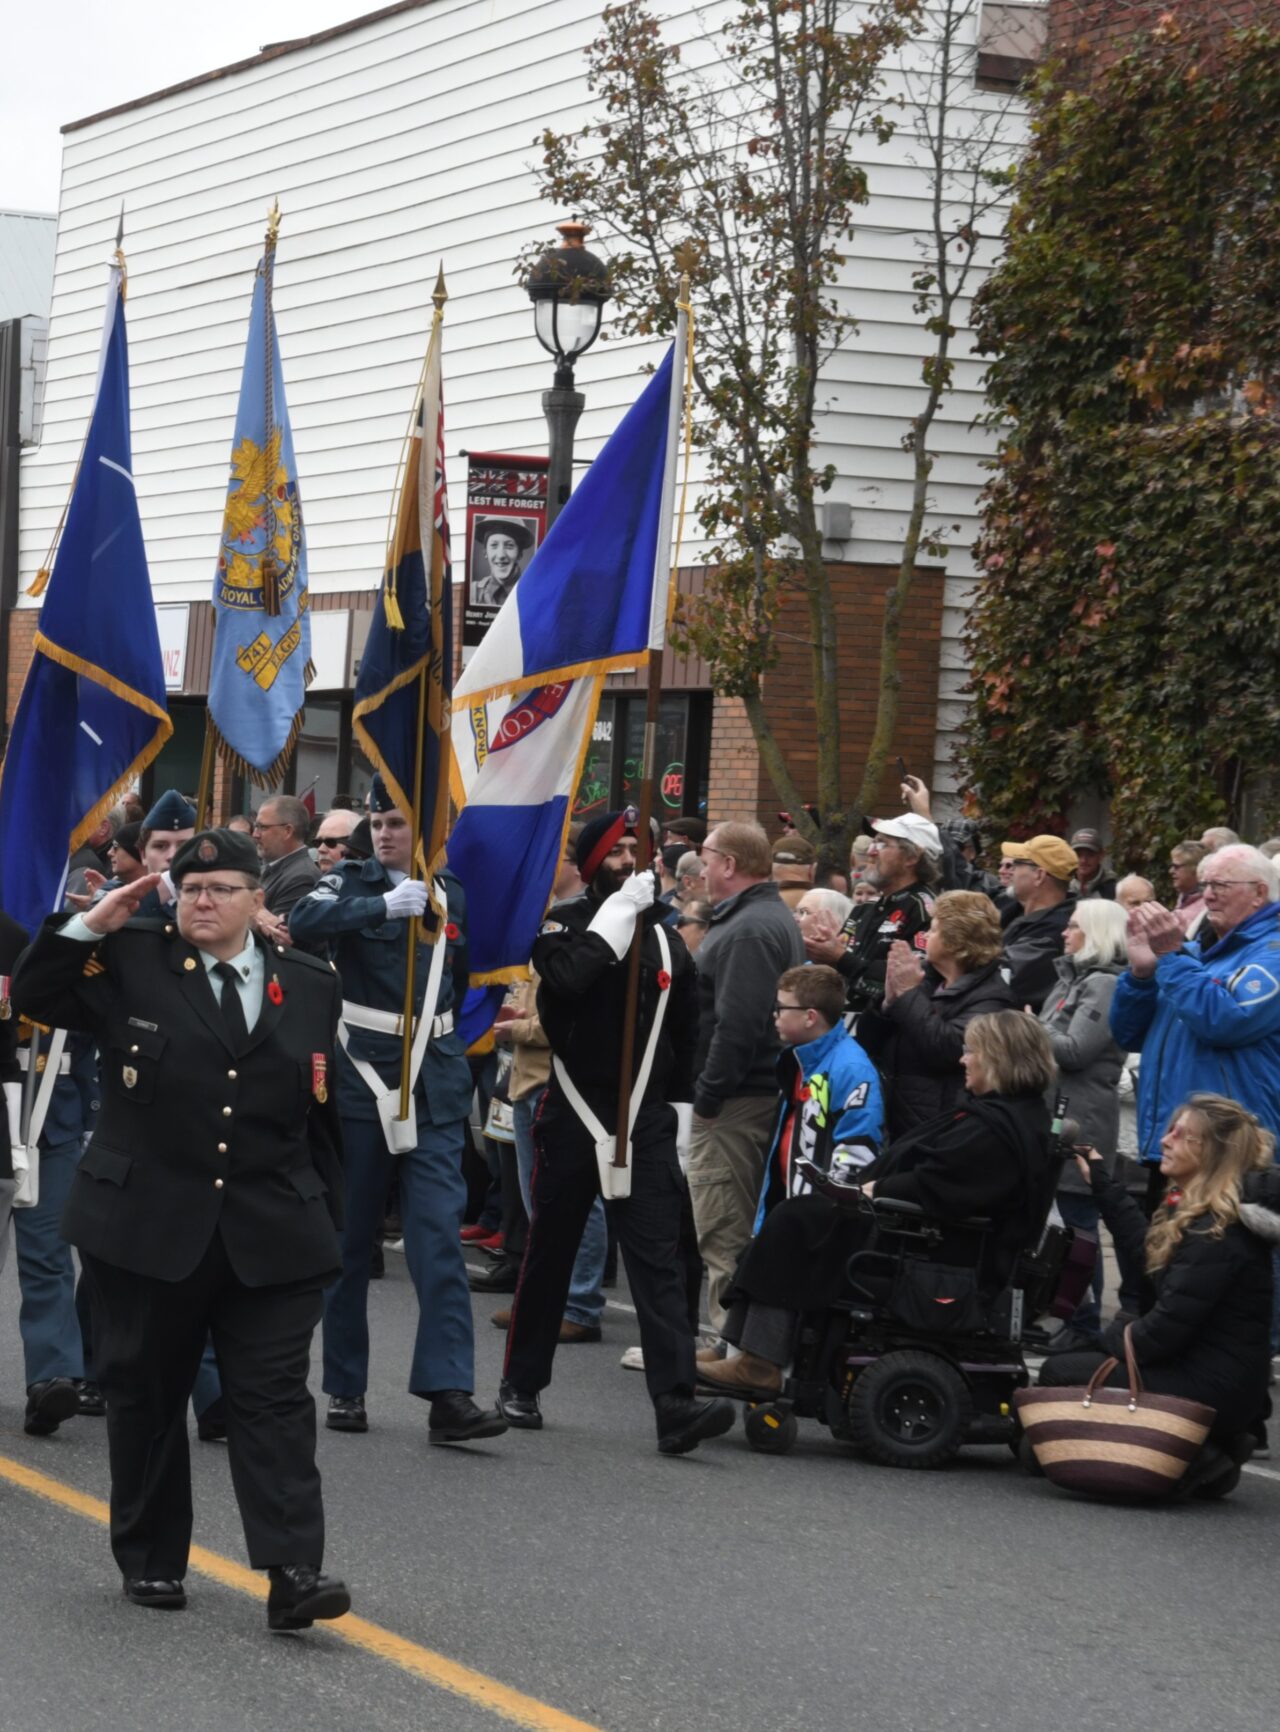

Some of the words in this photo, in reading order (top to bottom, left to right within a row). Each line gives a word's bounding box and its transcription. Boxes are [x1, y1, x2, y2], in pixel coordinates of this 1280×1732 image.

[469, 495, 491, 505] LEST
[493, 497, 507, 507] WE
[508, 498, 545, 509] FORGET
[221, 587, 257, 605] ROYAL
[242, 640, 267, 664] 741
[271, 629, 300, 669] ELGIN
[473, 706, 487, 761] KNOWL
